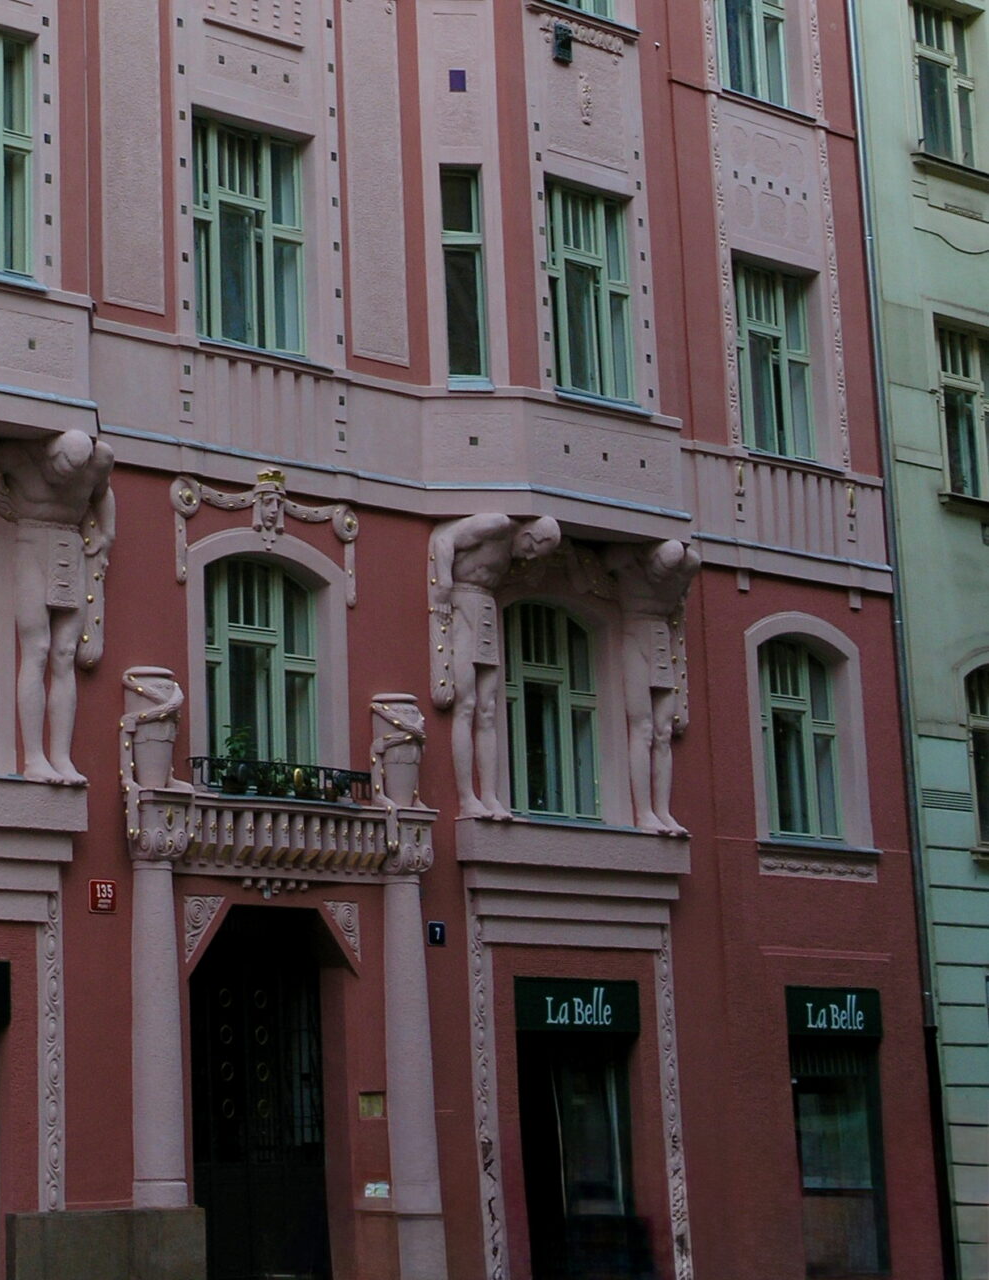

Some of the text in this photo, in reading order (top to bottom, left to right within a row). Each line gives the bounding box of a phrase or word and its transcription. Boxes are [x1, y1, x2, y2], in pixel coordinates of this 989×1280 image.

[96, 883, 113, 898] 135
[435, 927, 440, 940] 7
[545, 987, 612, 1025] La Belle
[806, 994, 864, 1030] La Belle
